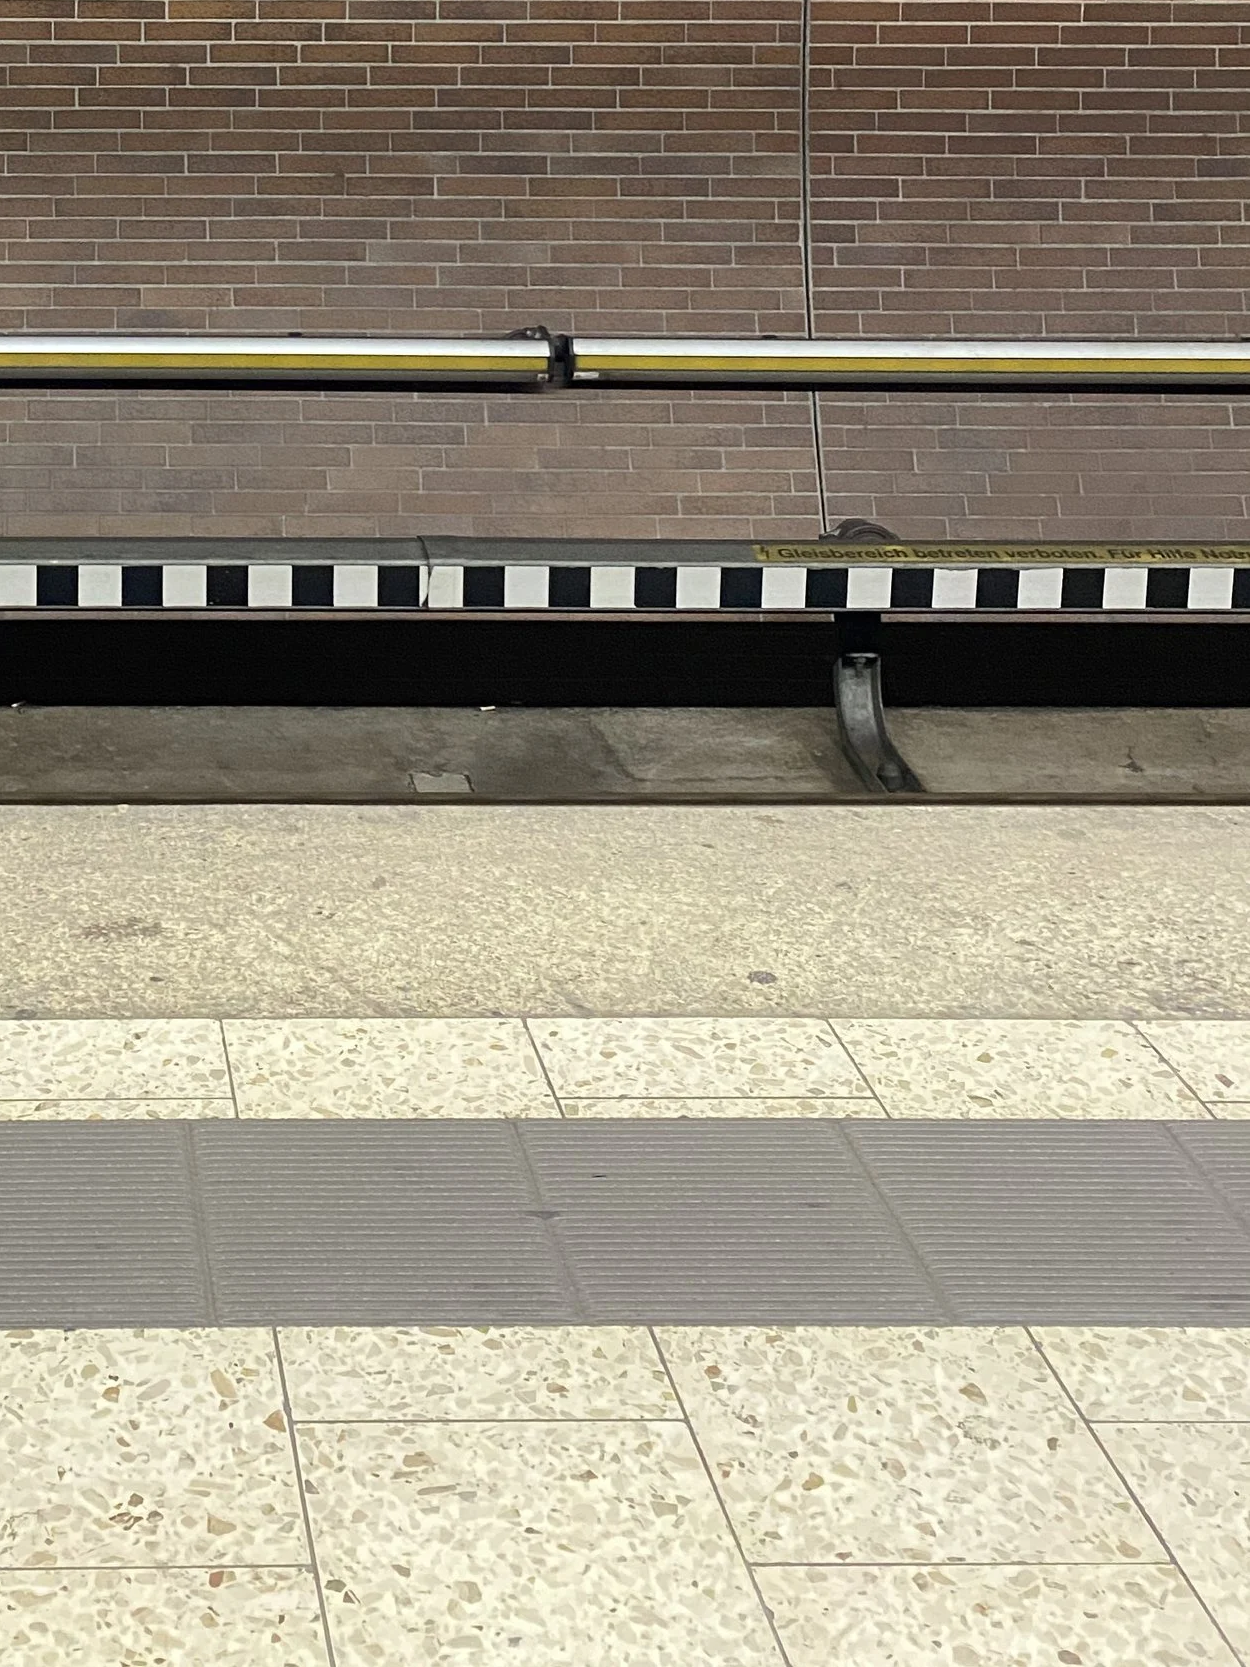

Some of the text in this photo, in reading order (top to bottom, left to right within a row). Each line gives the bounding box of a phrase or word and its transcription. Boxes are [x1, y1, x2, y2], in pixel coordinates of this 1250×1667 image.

[777, 547, 908, 560] Gleisbereich
[912, 547, 1000, 560] betreten
[1004, 547, 1103, 561] verboten.
[1107, 547, 1143, 560] Für
[1146, 547, 1198, 560] Hilfe
